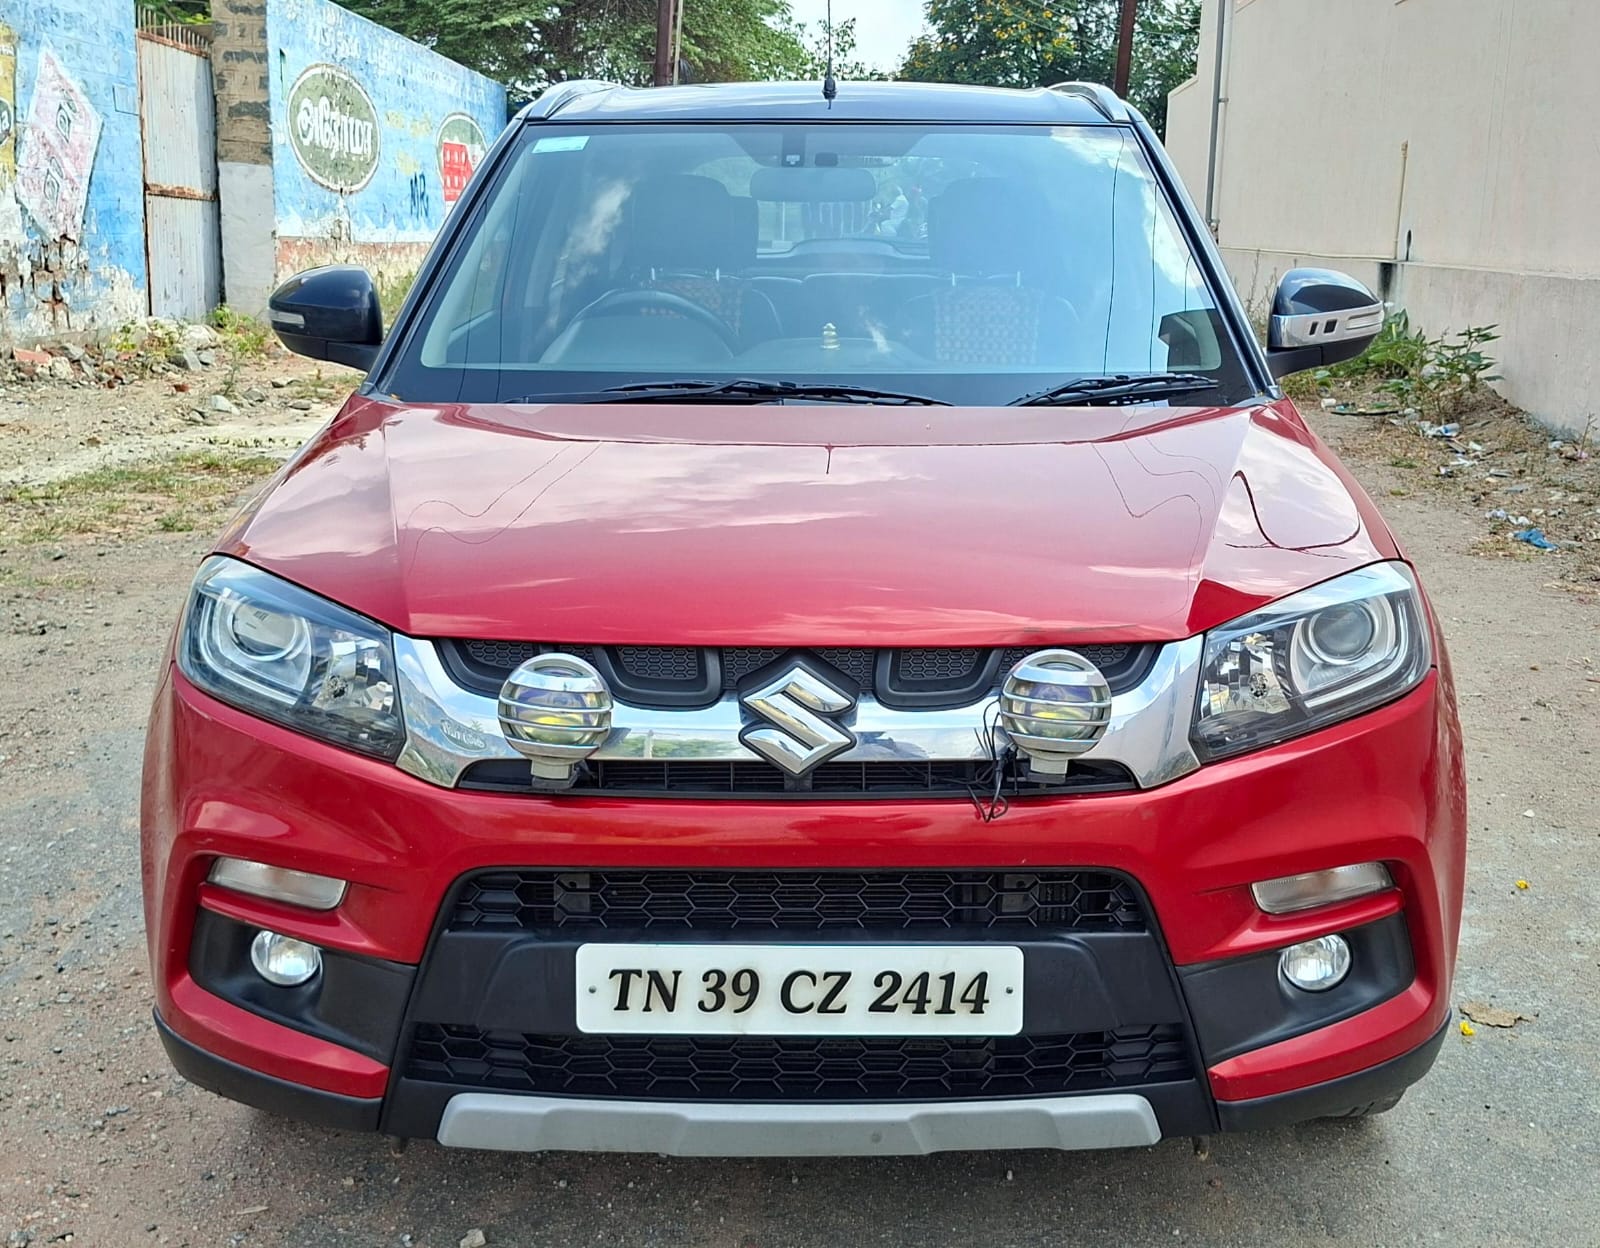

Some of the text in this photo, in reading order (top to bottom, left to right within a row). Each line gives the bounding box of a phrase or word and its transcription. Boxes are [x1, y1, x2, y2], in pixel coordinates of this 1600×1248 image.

[608, 968, 990, 1014] TN 39 CZ 2414
